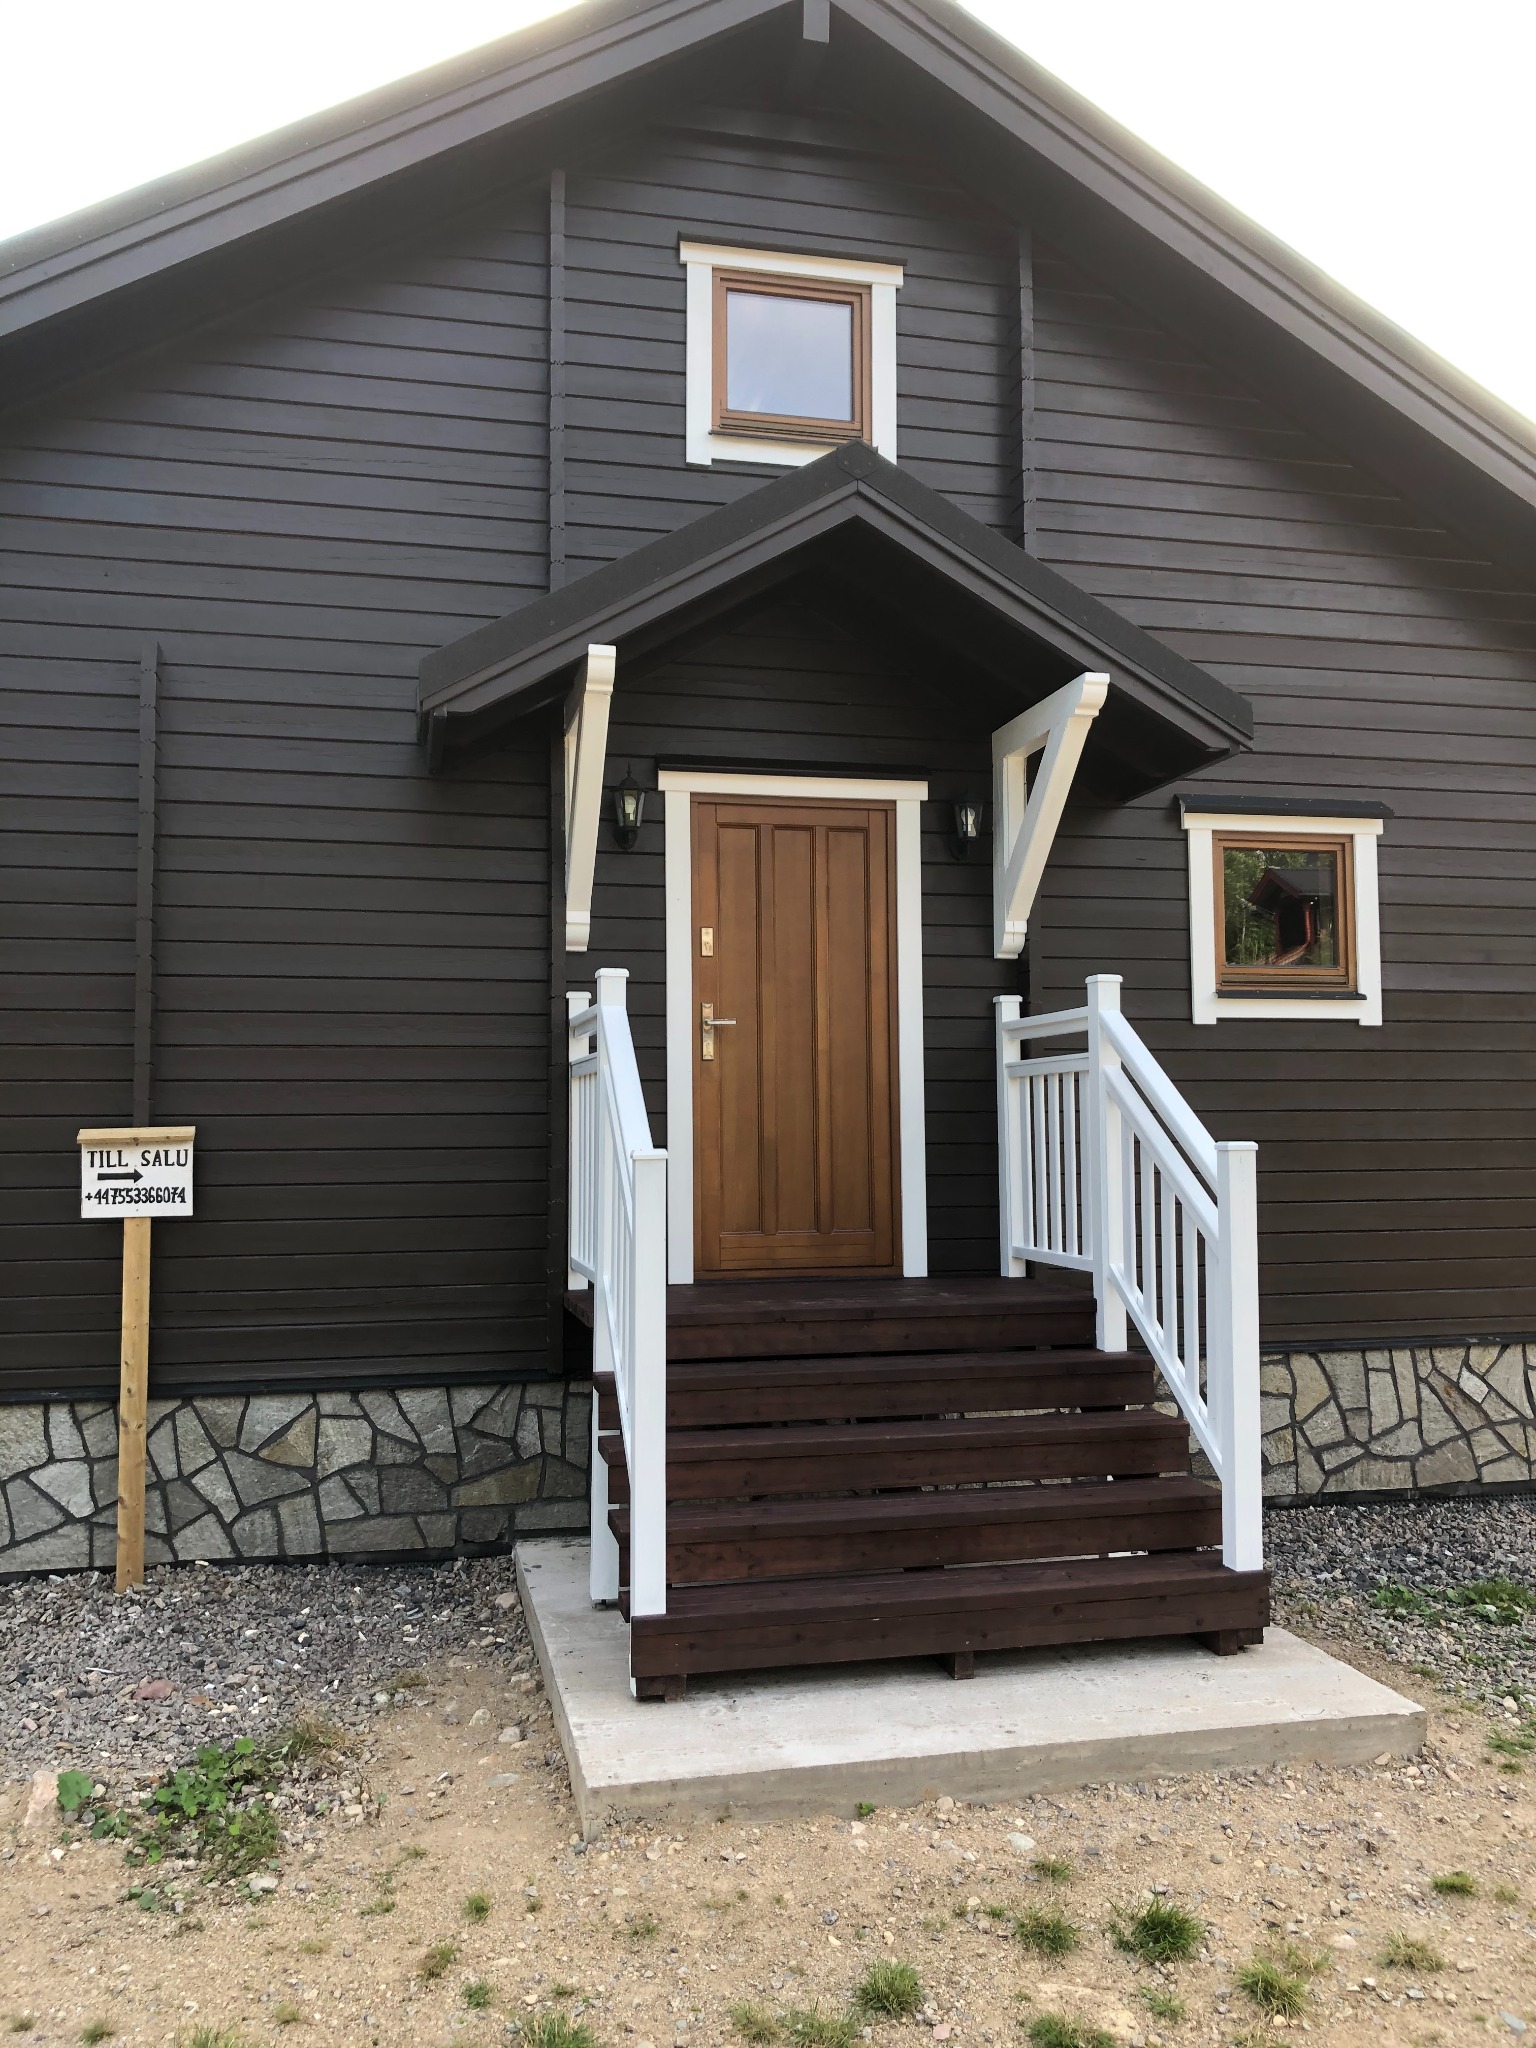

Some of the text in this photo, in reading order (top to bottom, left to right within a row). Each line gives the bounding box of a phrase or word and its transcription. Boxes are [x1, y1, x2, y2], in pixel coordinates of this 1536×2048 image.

[87, 1149, 189, 1168] TILL SALU
[85, 1186, 187, 1205] +447553366074
